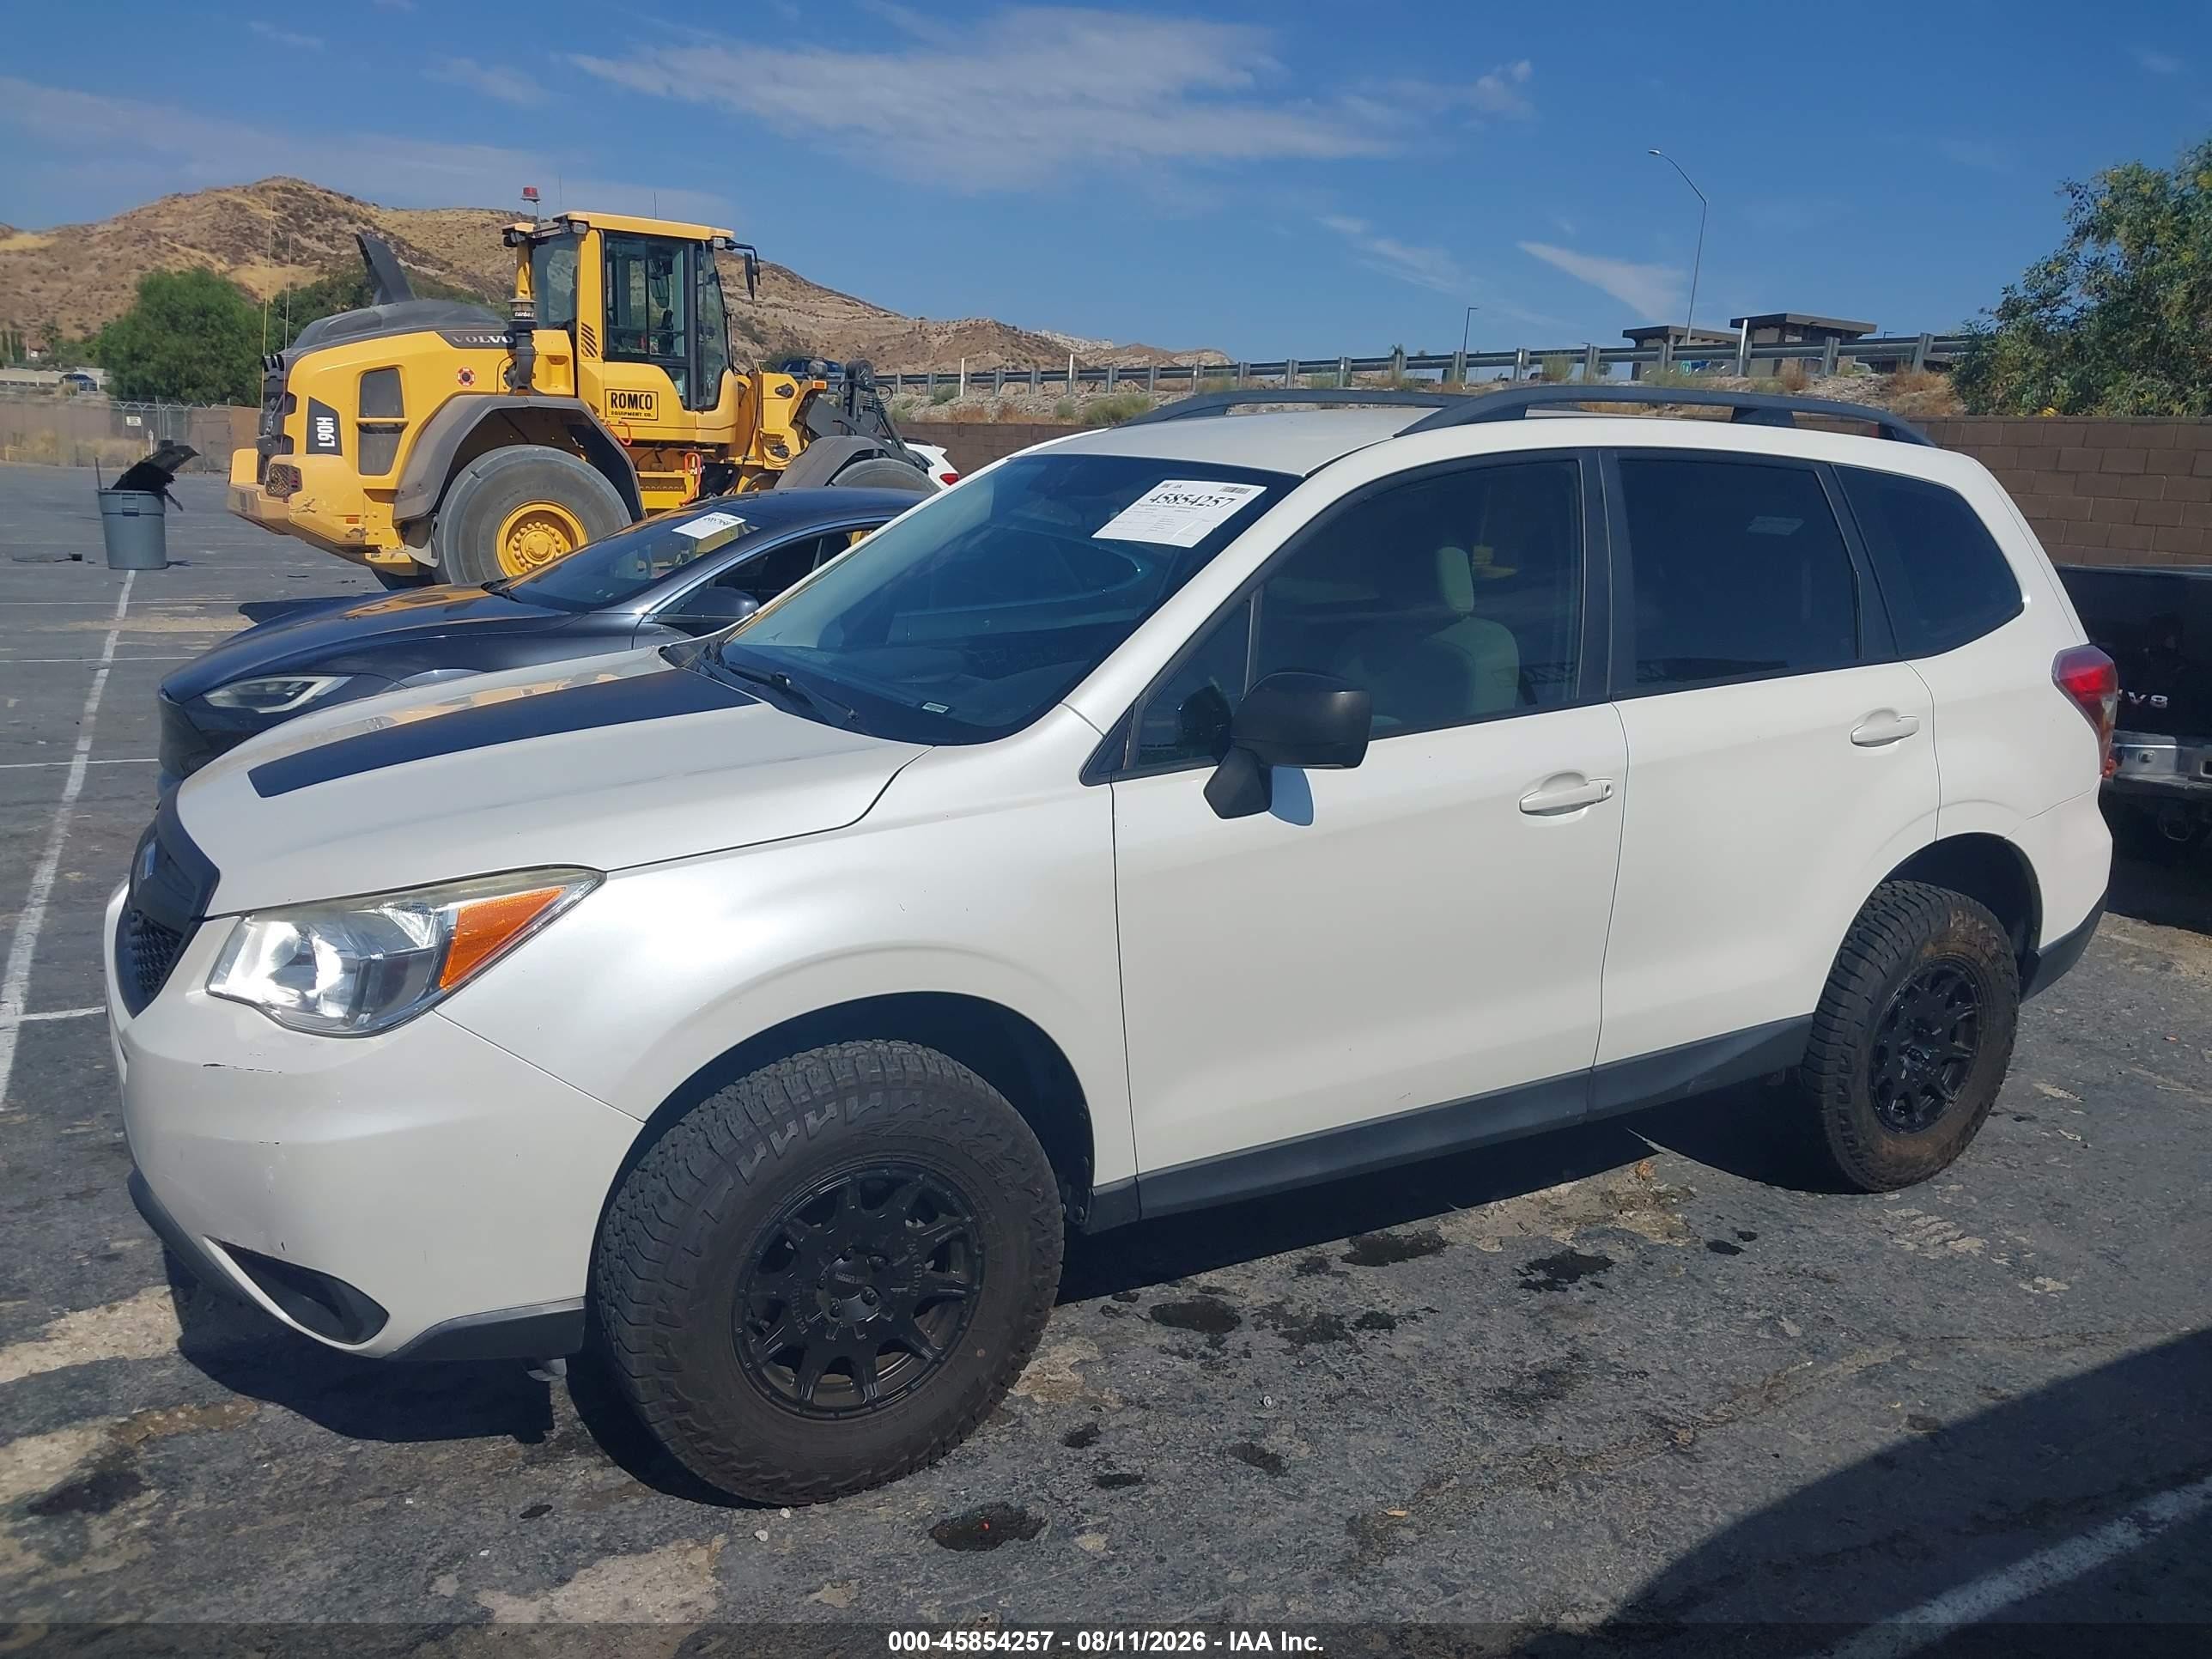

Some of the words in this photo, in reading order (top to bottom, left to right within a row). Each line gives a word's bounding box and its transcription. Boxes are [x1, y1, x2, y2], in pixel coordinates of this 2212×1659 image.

[452, 335, 514, 343] VOLVO
[611, 392, 653, 410] ROMCO
[315, 416, 336, 447] L90H
[1149, 492, 1237, 508] 45854257
